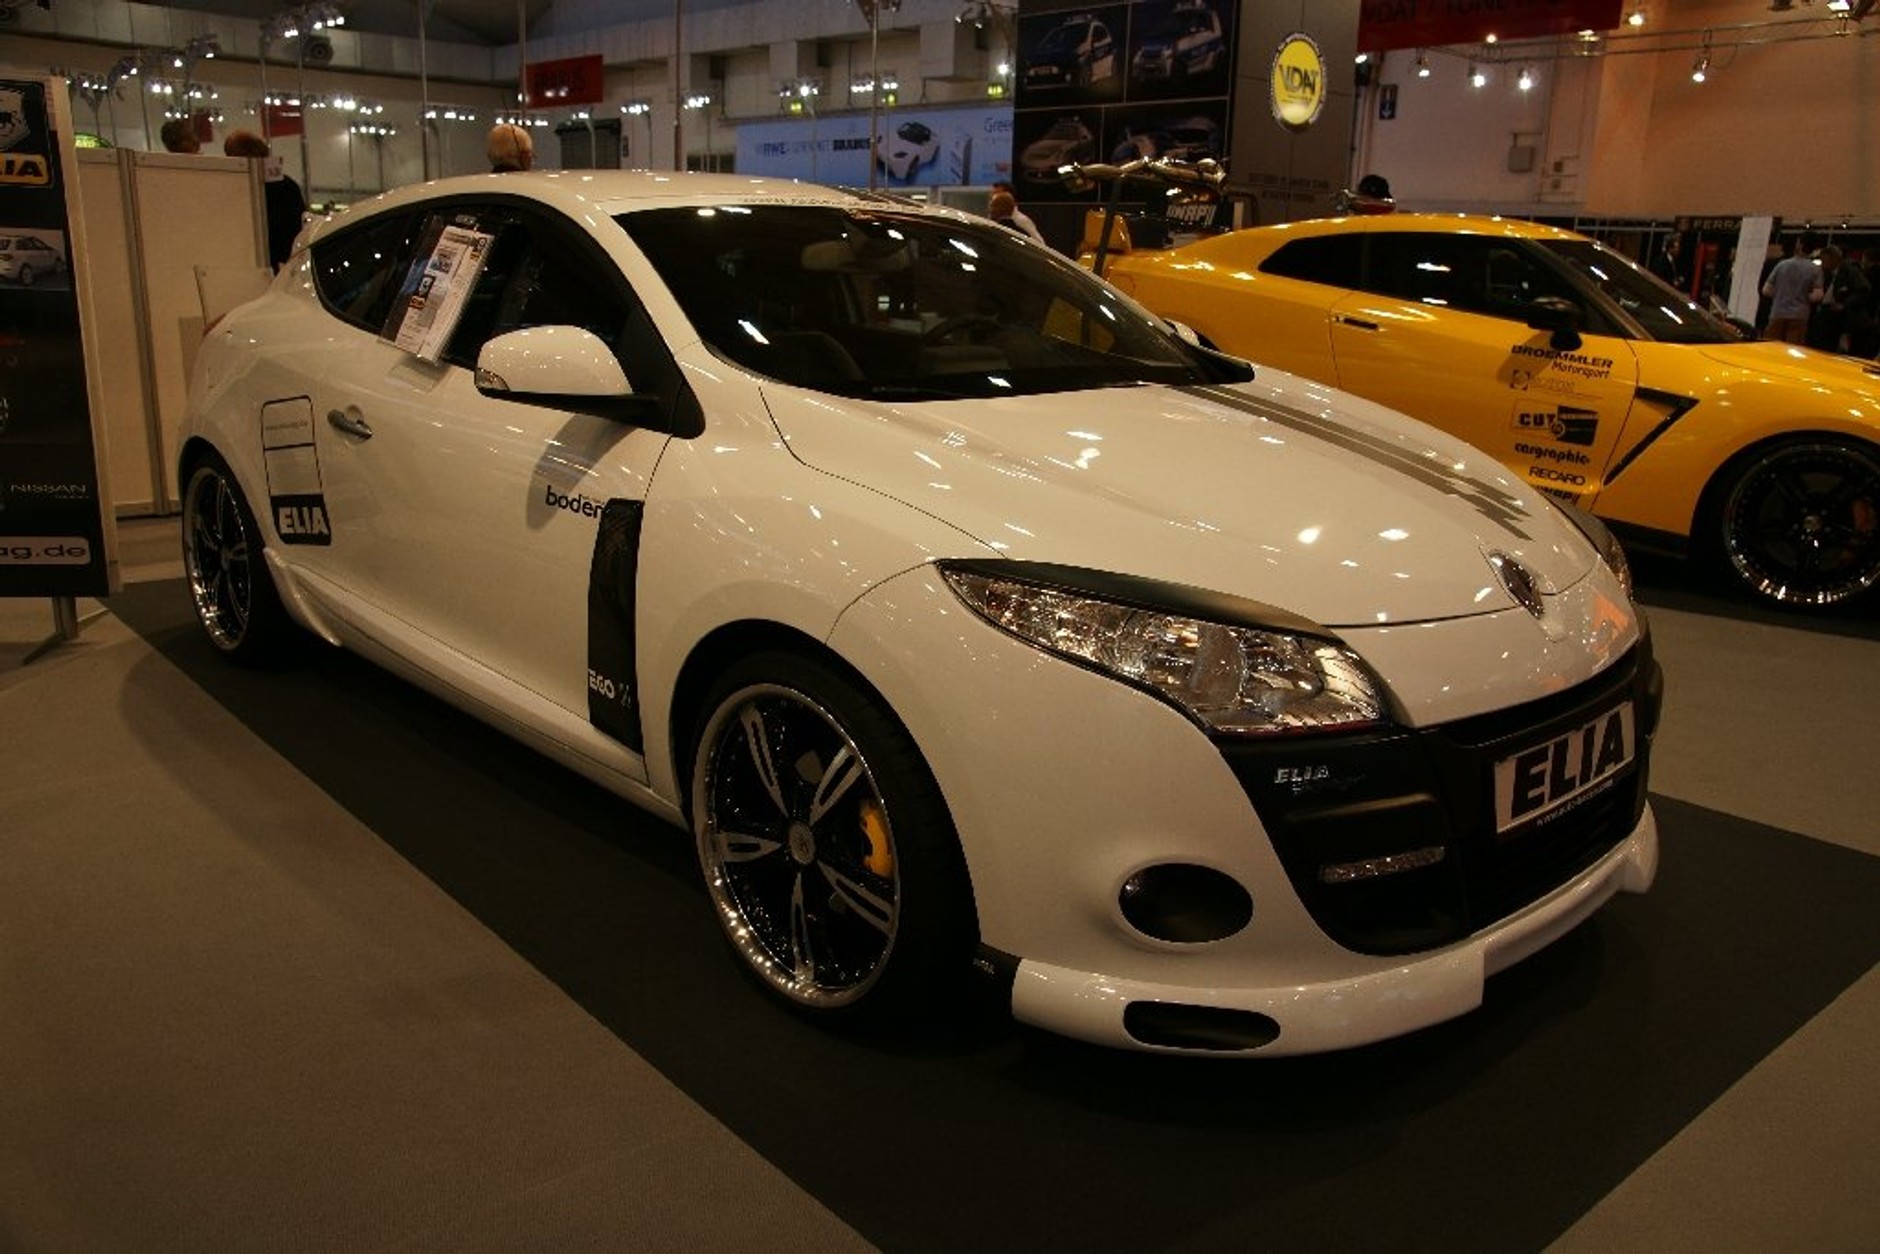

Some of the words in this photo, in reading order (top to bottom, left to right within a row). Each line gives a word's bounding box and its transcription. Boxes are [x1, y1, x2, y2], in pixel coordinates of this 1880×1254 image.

[984, 117, 1013, 133] Gree
[0, 160, 43, 177] IA
[1529, 466, 1585, 486] RECARO
[278, 506, 329, 535] ELIA
[1511, 710, 1626, 821] ELIA
